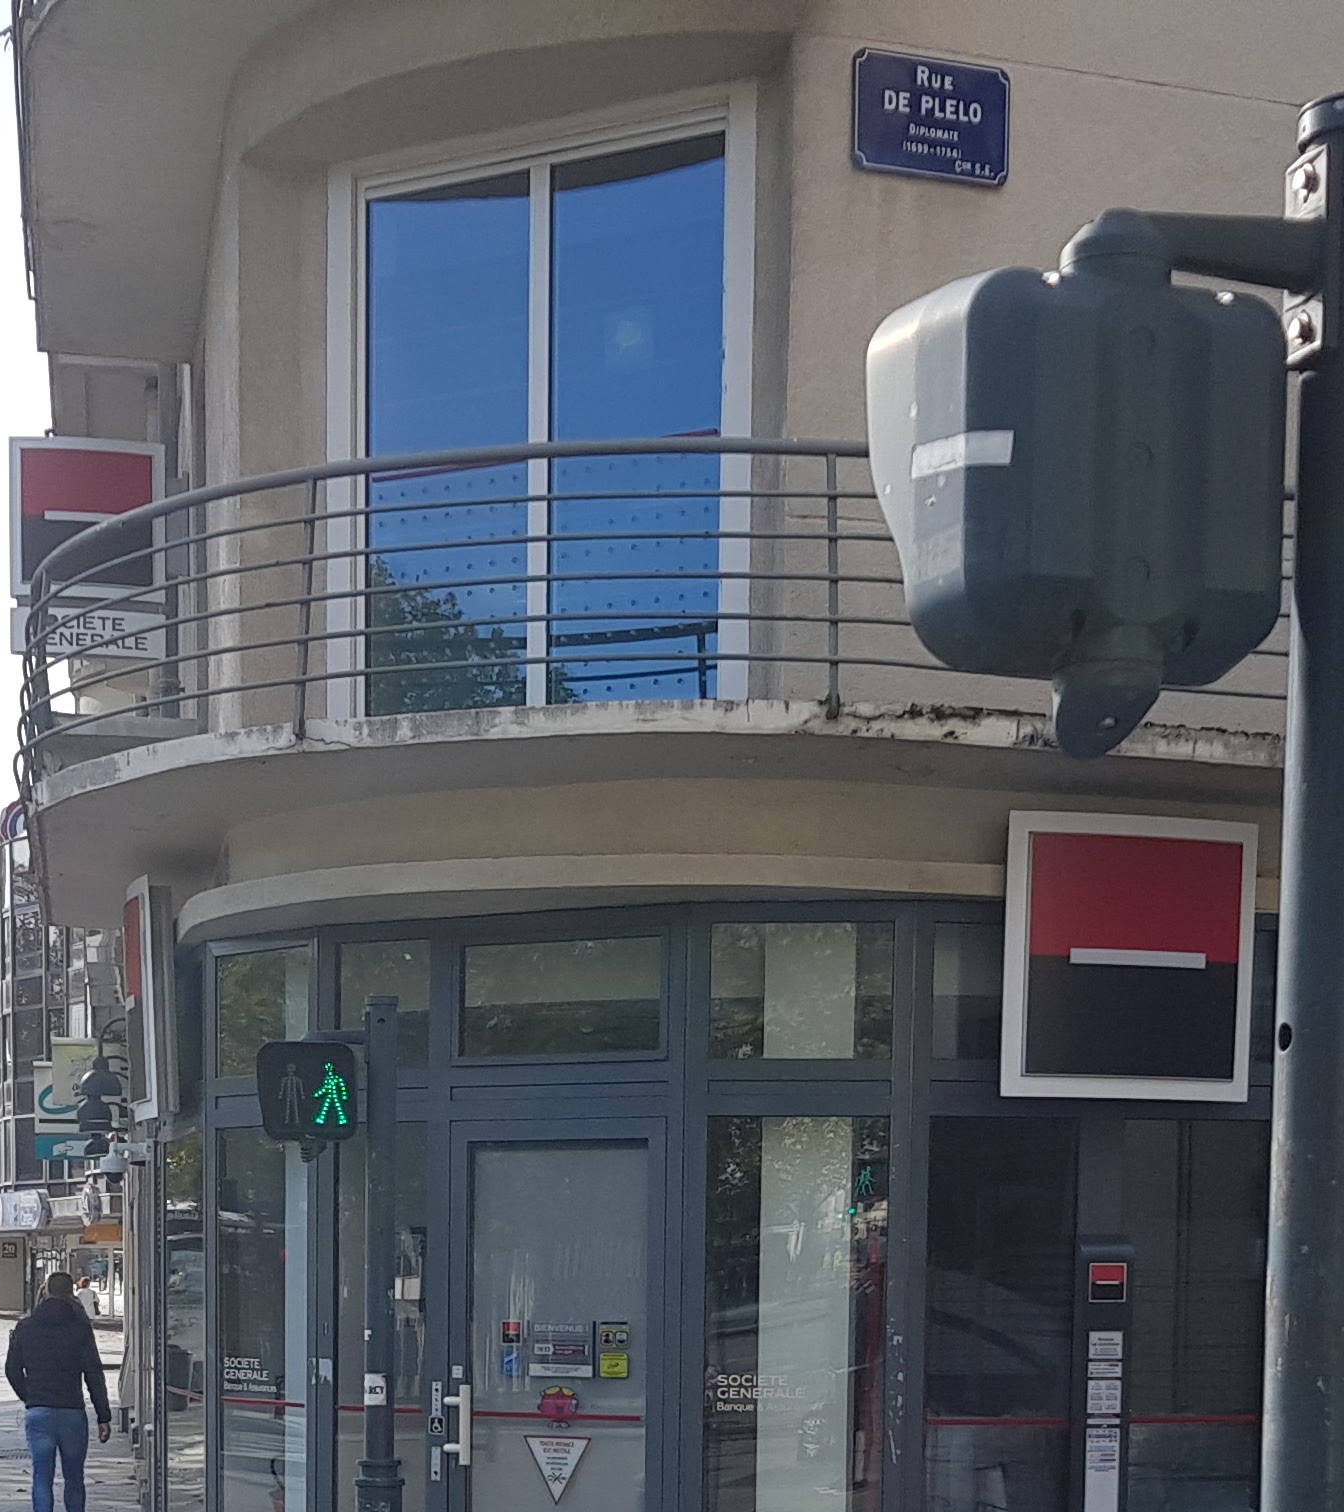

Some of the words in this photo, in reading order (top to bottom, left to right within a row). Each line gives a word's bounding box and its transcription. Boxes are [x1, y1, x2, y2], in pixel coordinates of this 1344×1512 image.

[884, 89, 911, 113] DE
[921, 94, 982, 123] PLELO
[4, 1243, 15, 1254] 20
[224, 1357, 260, 1368] SOCIETE
[224, 1369, 268, 1380] GENERALE
[717, 1375, 787, 1386] SOCIETE
[717, 1388, 805, 1399] GENERALE
[716, 1402, 754, 1412] Banque
